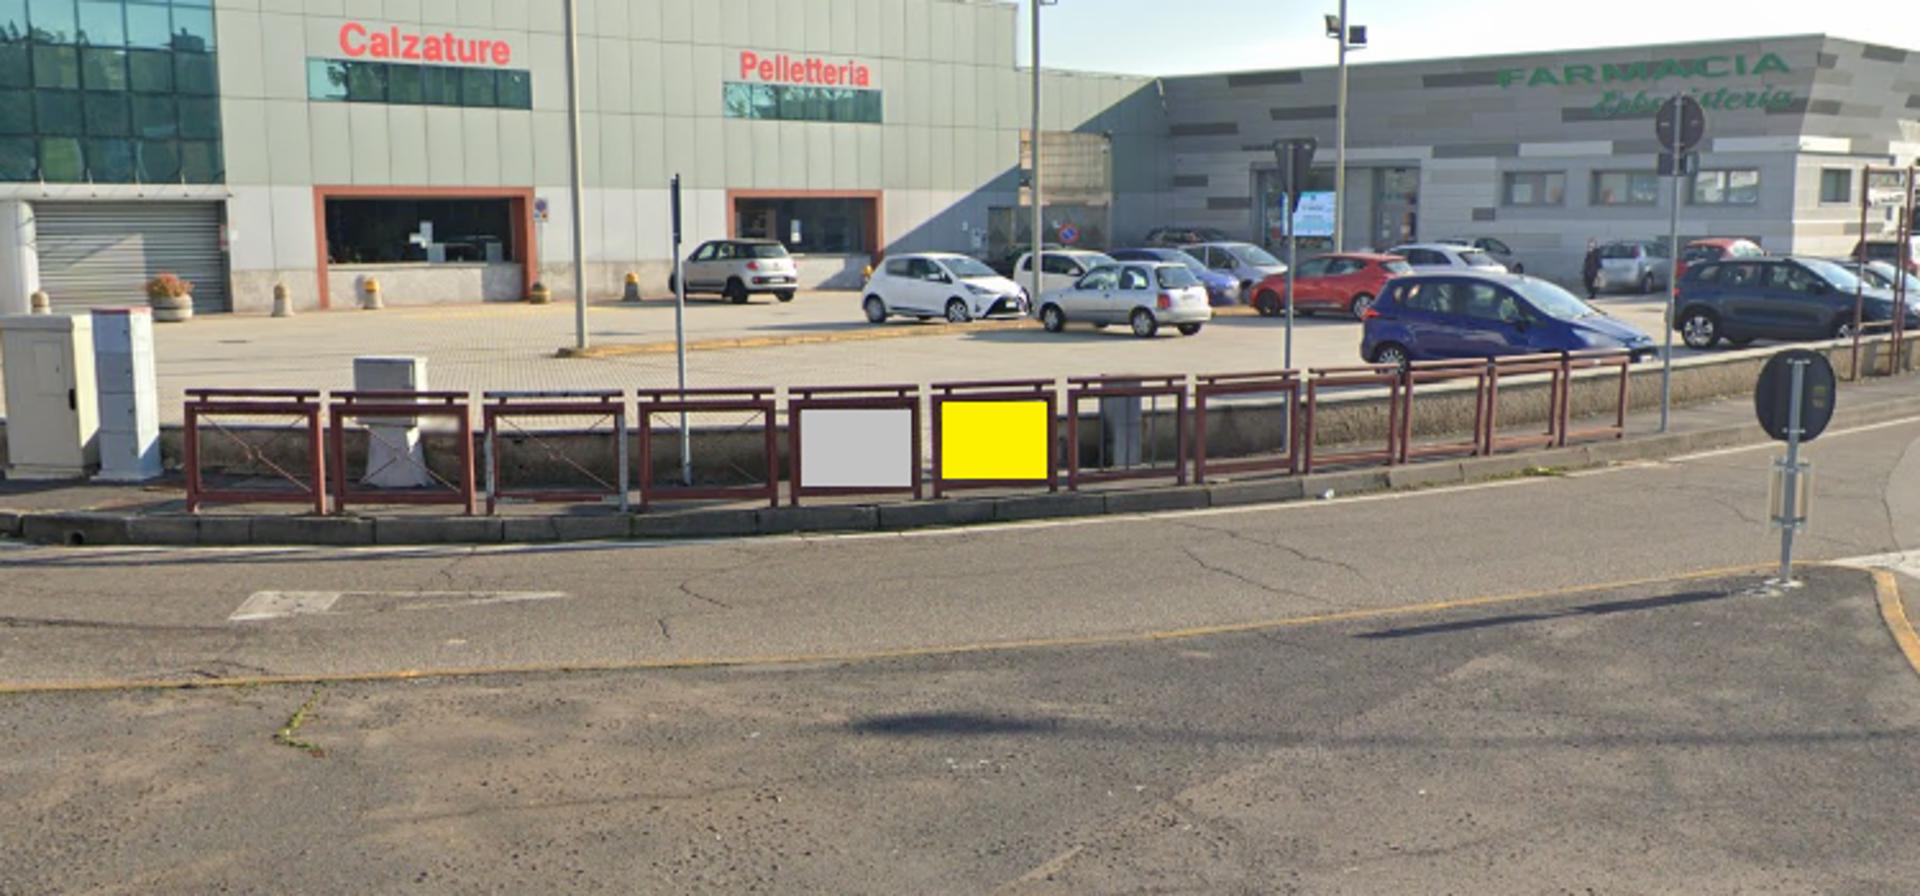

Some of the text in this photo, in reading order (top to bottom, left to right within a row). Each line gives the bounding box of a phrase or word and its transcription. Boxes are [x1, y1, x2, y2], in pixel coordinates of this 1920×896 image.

[338, 22, 512, 65] Calzature
[740, 51, 870, 87] Pelletteria
[1496, 53, 1791, 87] FARMACIA
